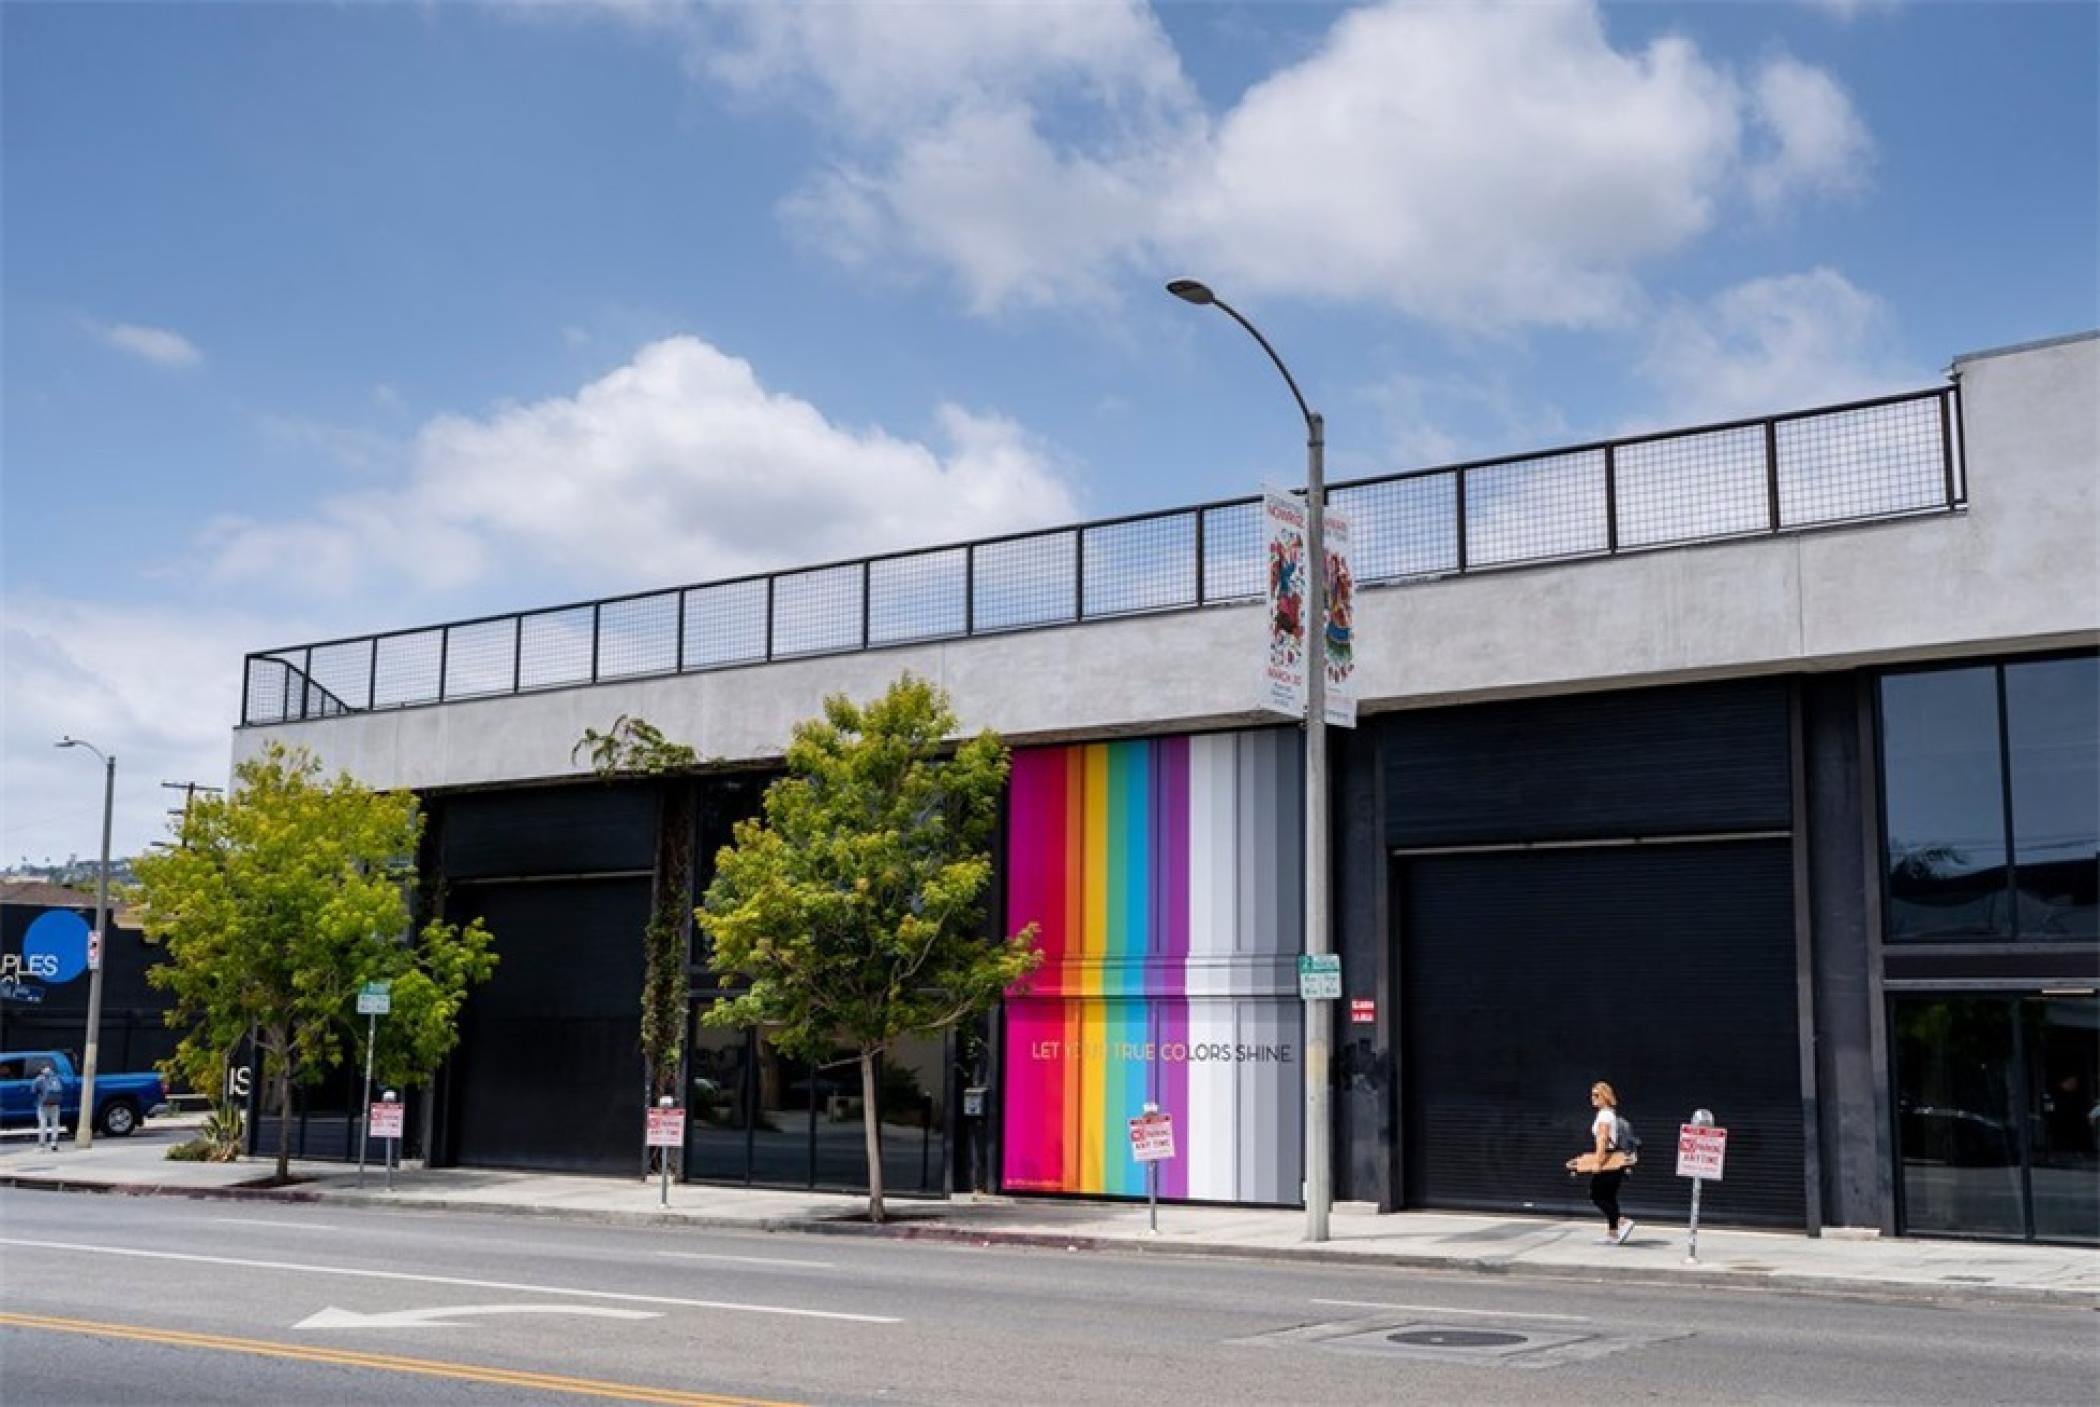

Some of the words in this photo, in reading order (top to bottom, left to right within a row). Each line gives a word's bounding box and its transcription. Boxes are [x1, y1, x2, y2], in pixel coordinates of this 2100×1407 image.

[1032, 1041, 1059, 1059] LET
[1113, 1043, 1155, 1061] TRUE
[1161, 1044, 1231, 1062] COLORS
